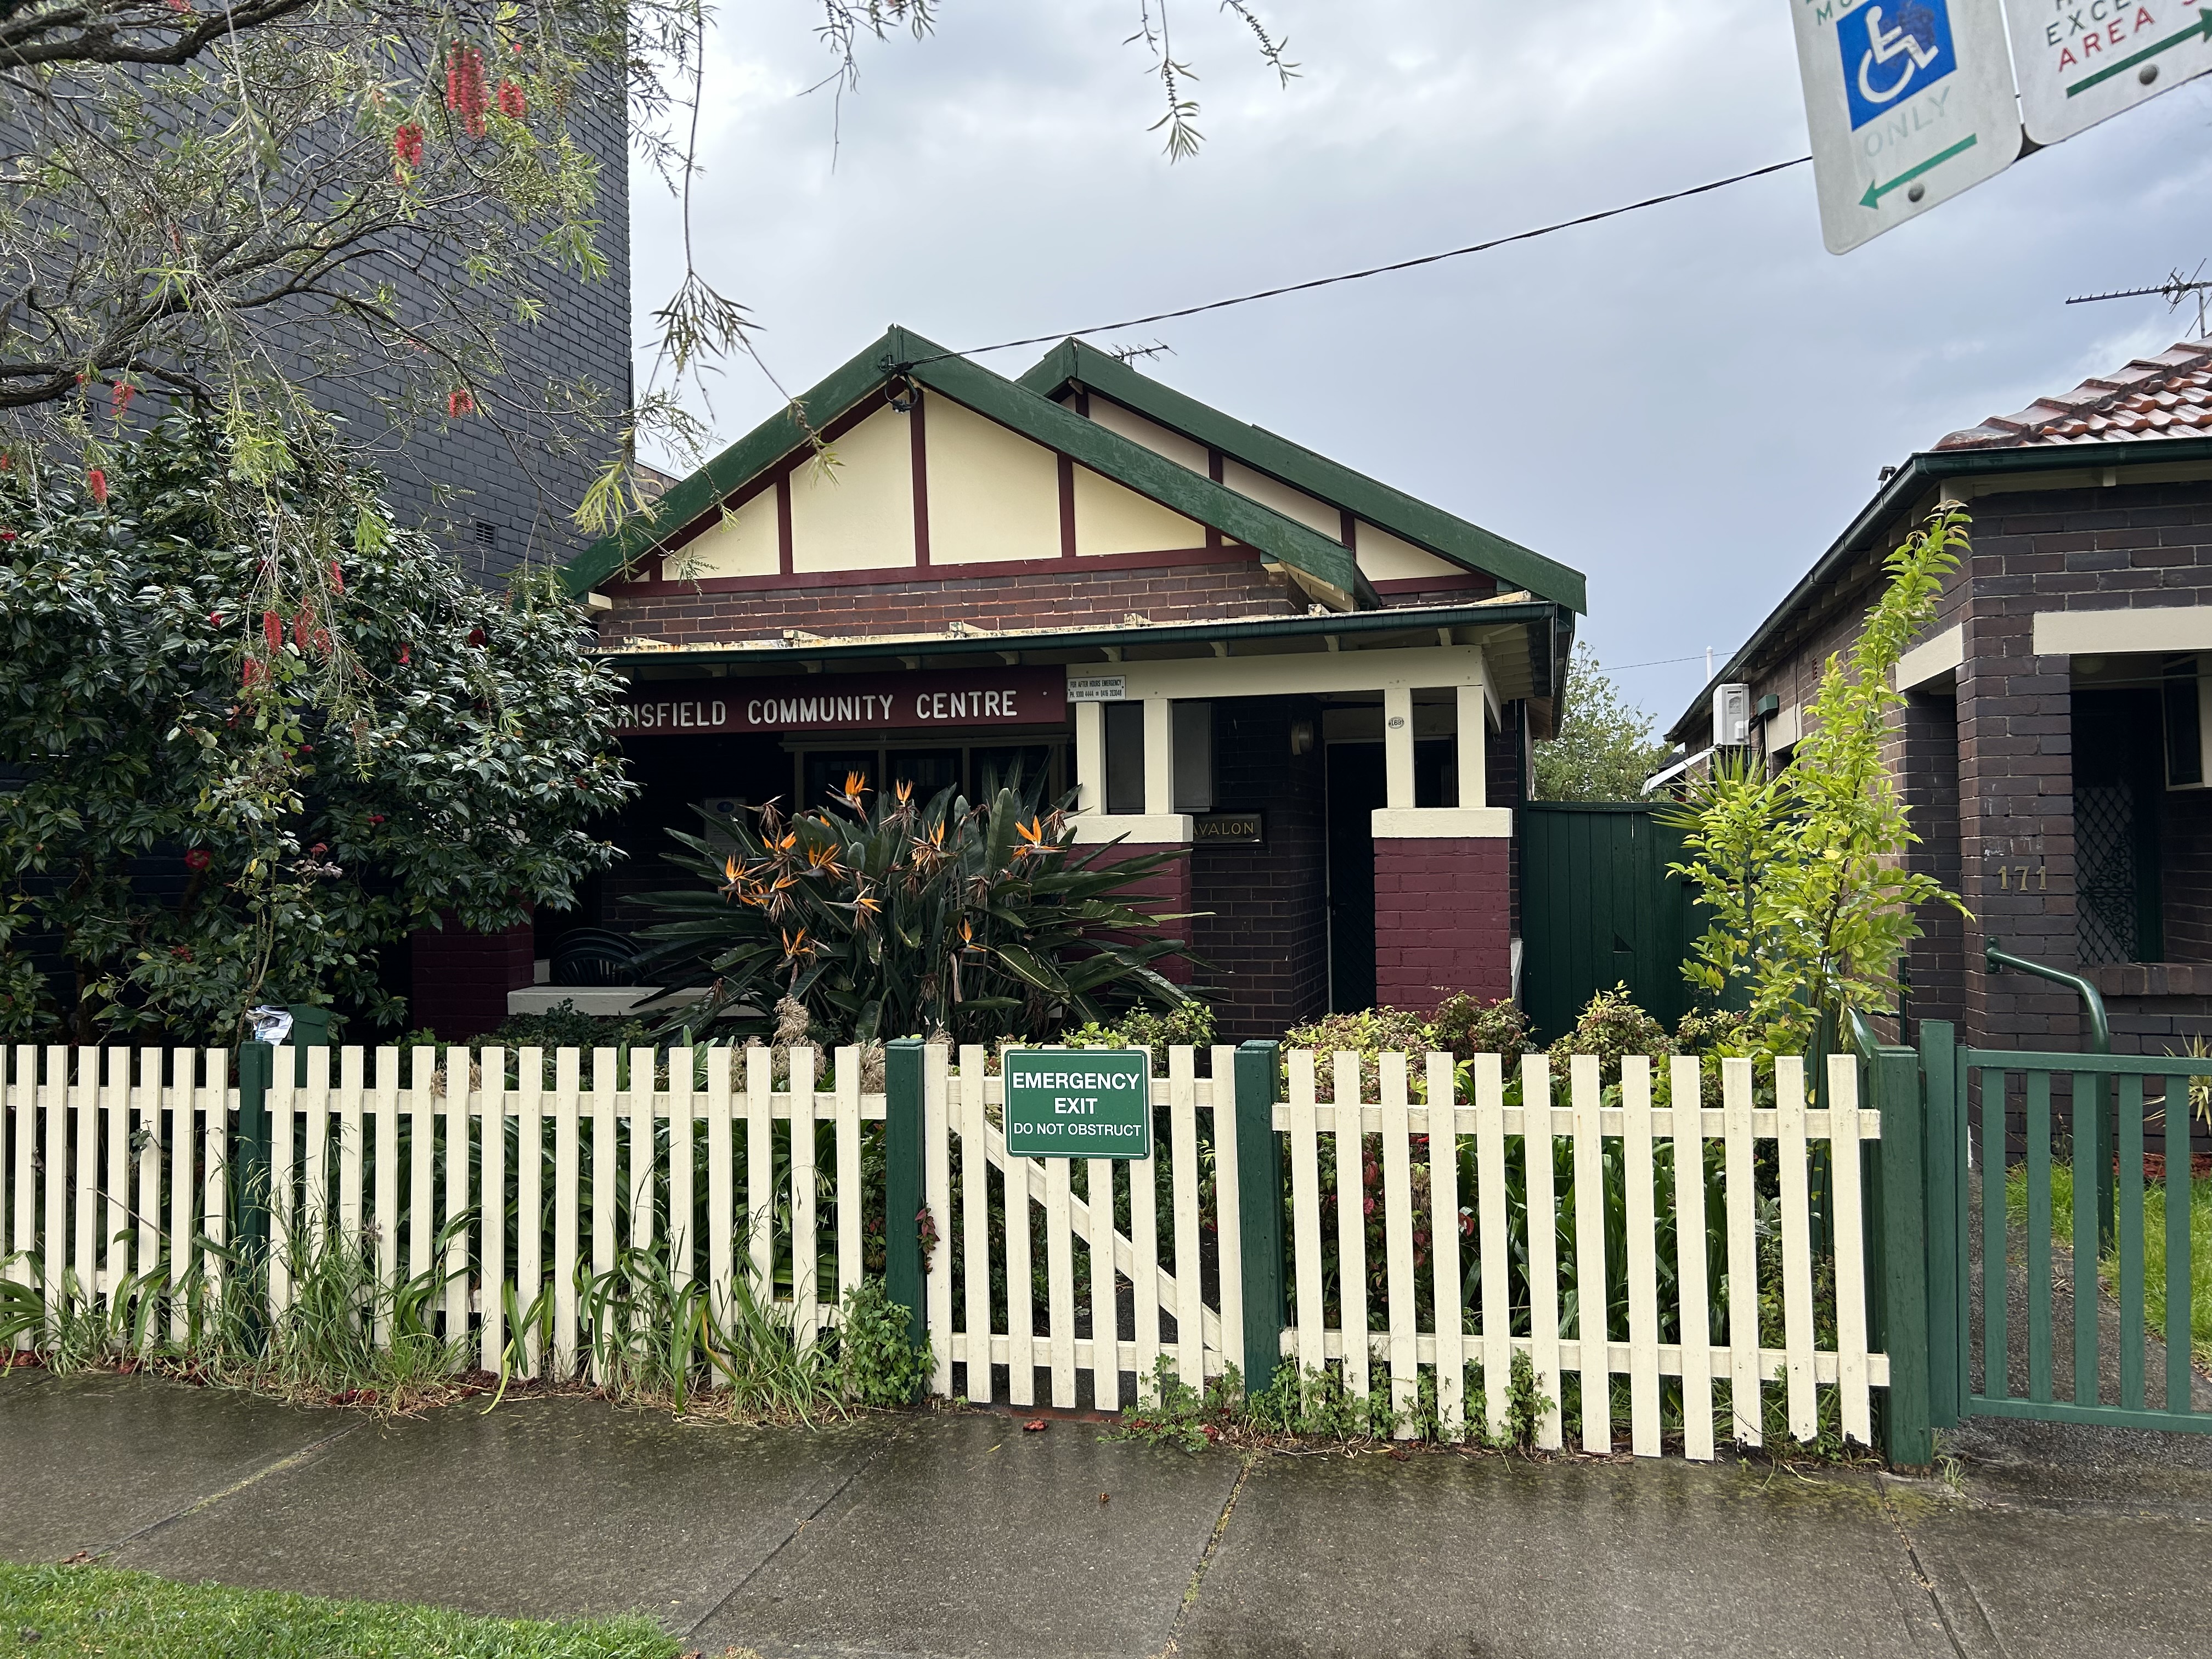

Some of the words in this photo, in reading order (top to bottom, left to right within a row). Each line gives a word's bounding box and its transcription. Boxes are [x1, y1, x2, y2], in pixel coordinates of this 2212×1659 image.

[2046, 0, 2133, 47] EXCE
[2058, 6, 2155, 72] AREA
[1864, 85, 1951, 157] ONLY
[748, 694, 894, 725] COMMUNITY
[917, 691, 1017, 719] CENTRE
[1997, 866, 2047, 891] 171
[1013, 1072, 1140, 1090] EMERGENCY
[1054, 1097, 1098, 1114] EXIT
[1014, 1122, 1033, 1135] DO
[1037, 1123, 1064, 1135] NOT
[1068, 1124, 1142, 1137] OBSTRUCT
